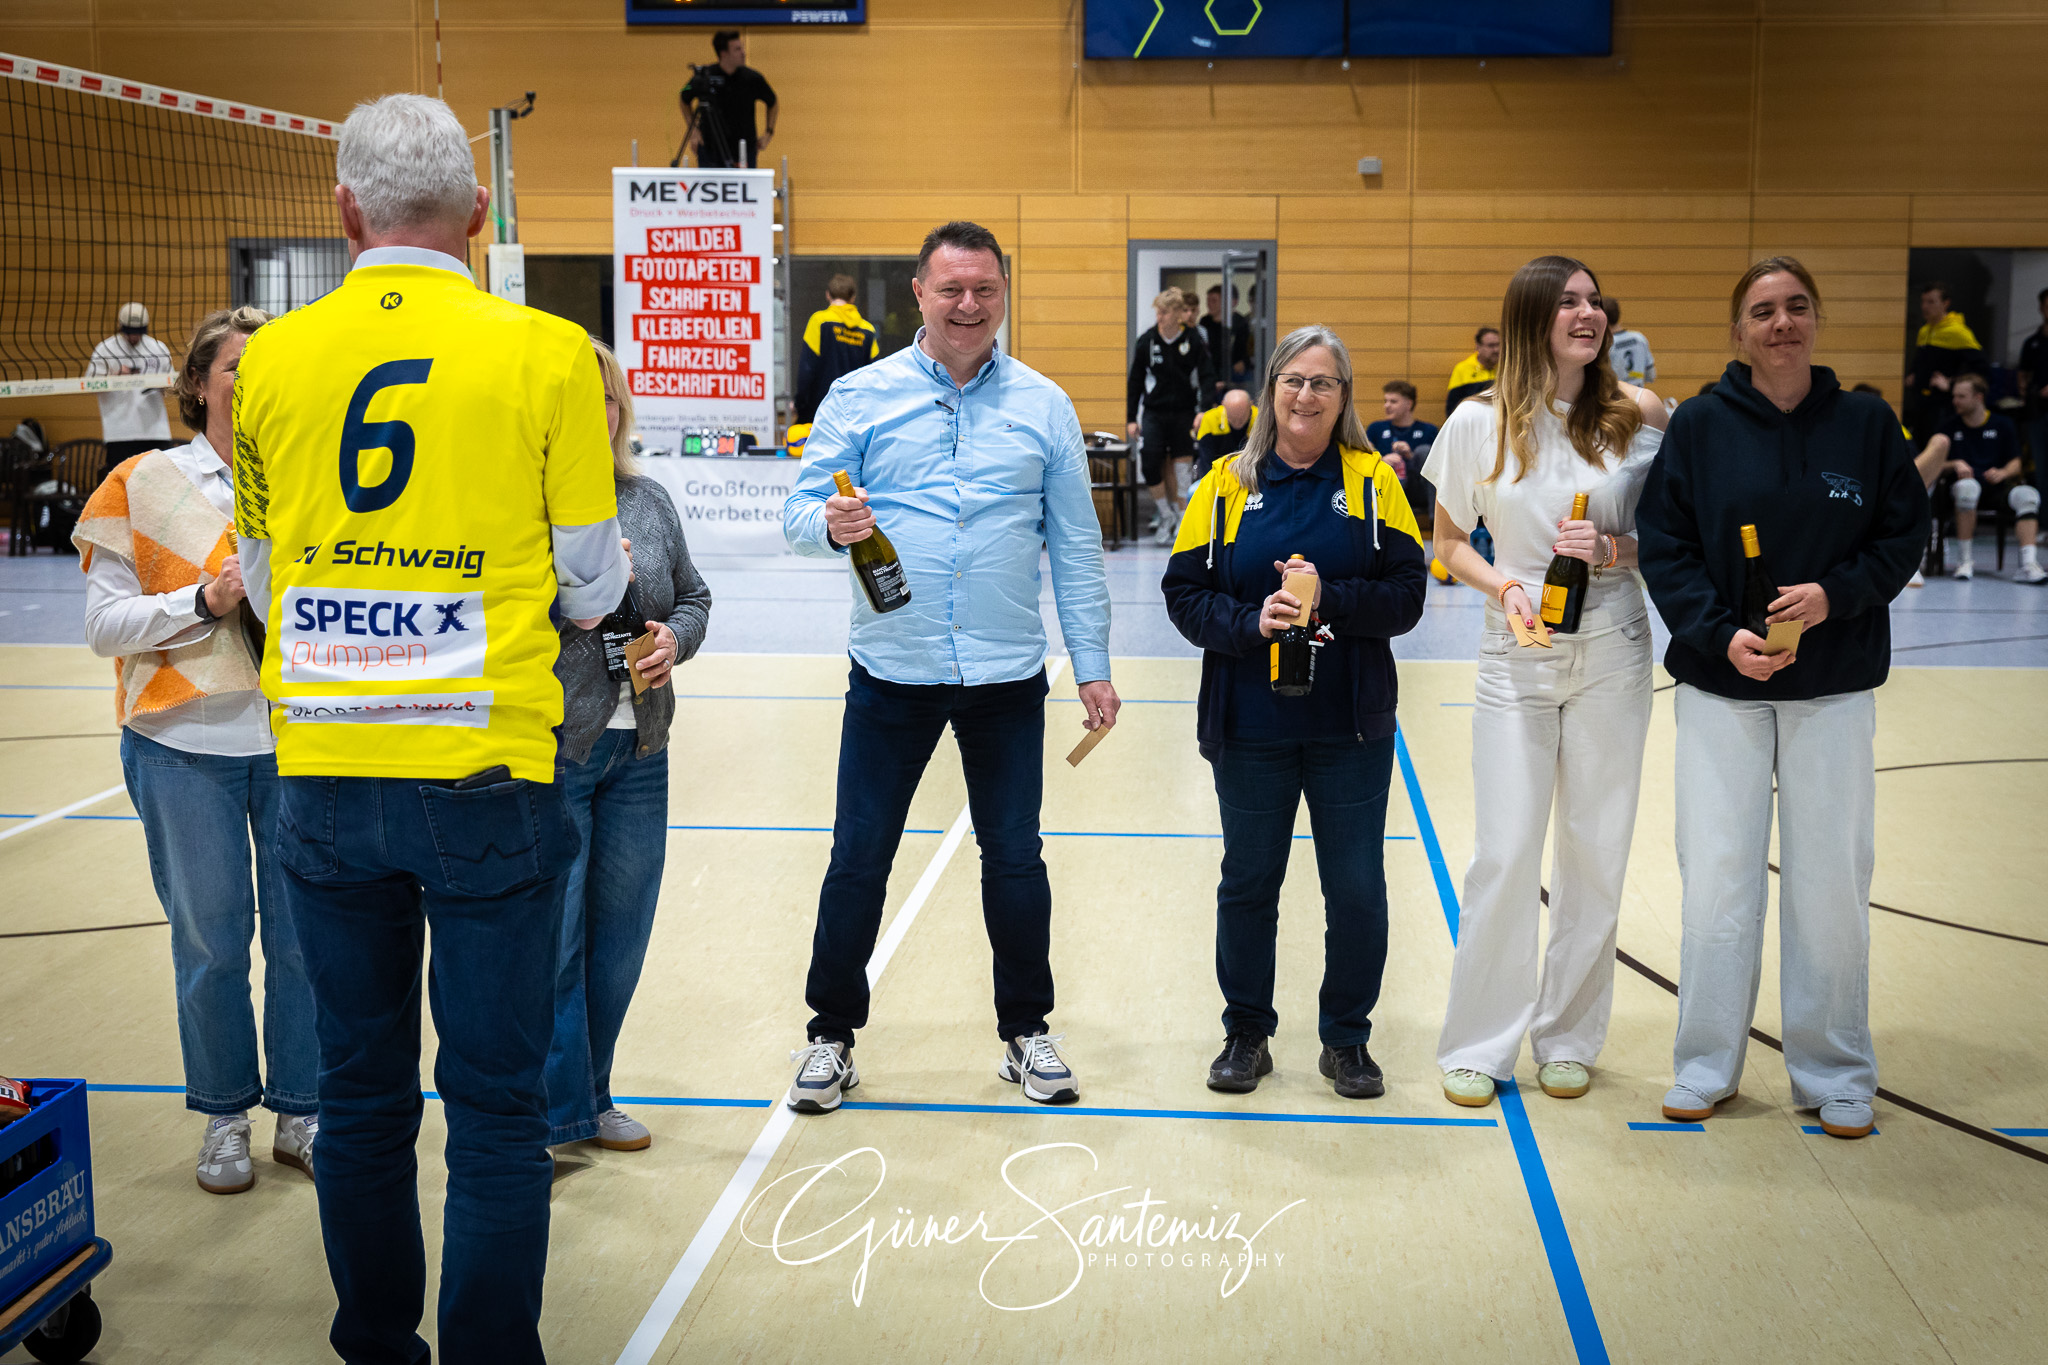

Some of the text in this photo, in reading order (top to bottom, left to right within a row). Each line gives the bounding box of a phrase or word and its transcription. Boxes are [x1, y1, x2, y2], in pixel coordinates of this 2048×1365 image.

[792, 10, 848, 23] PEWETA
[630, 181, 758, 203] MEYSEL
[650, 227, 736, 253] SCHILDER
[632, 257, 752, 281] FOTOTAPETEN
[649, 286, 742, 311] SCHRIFTEN
[638, 317, 752, 341] KLEBEFOLIEN
[648, 345, 748, 370] FAHRZEUG-
[633, 372, 763, 398] BESCHRIFTUNG
[339, 357, 434, 514] 6
[332, 540, 485, 578] Schwaig
[294, 597, 424, 637] SPECK
[292, 641, 427, 672] pumpen
